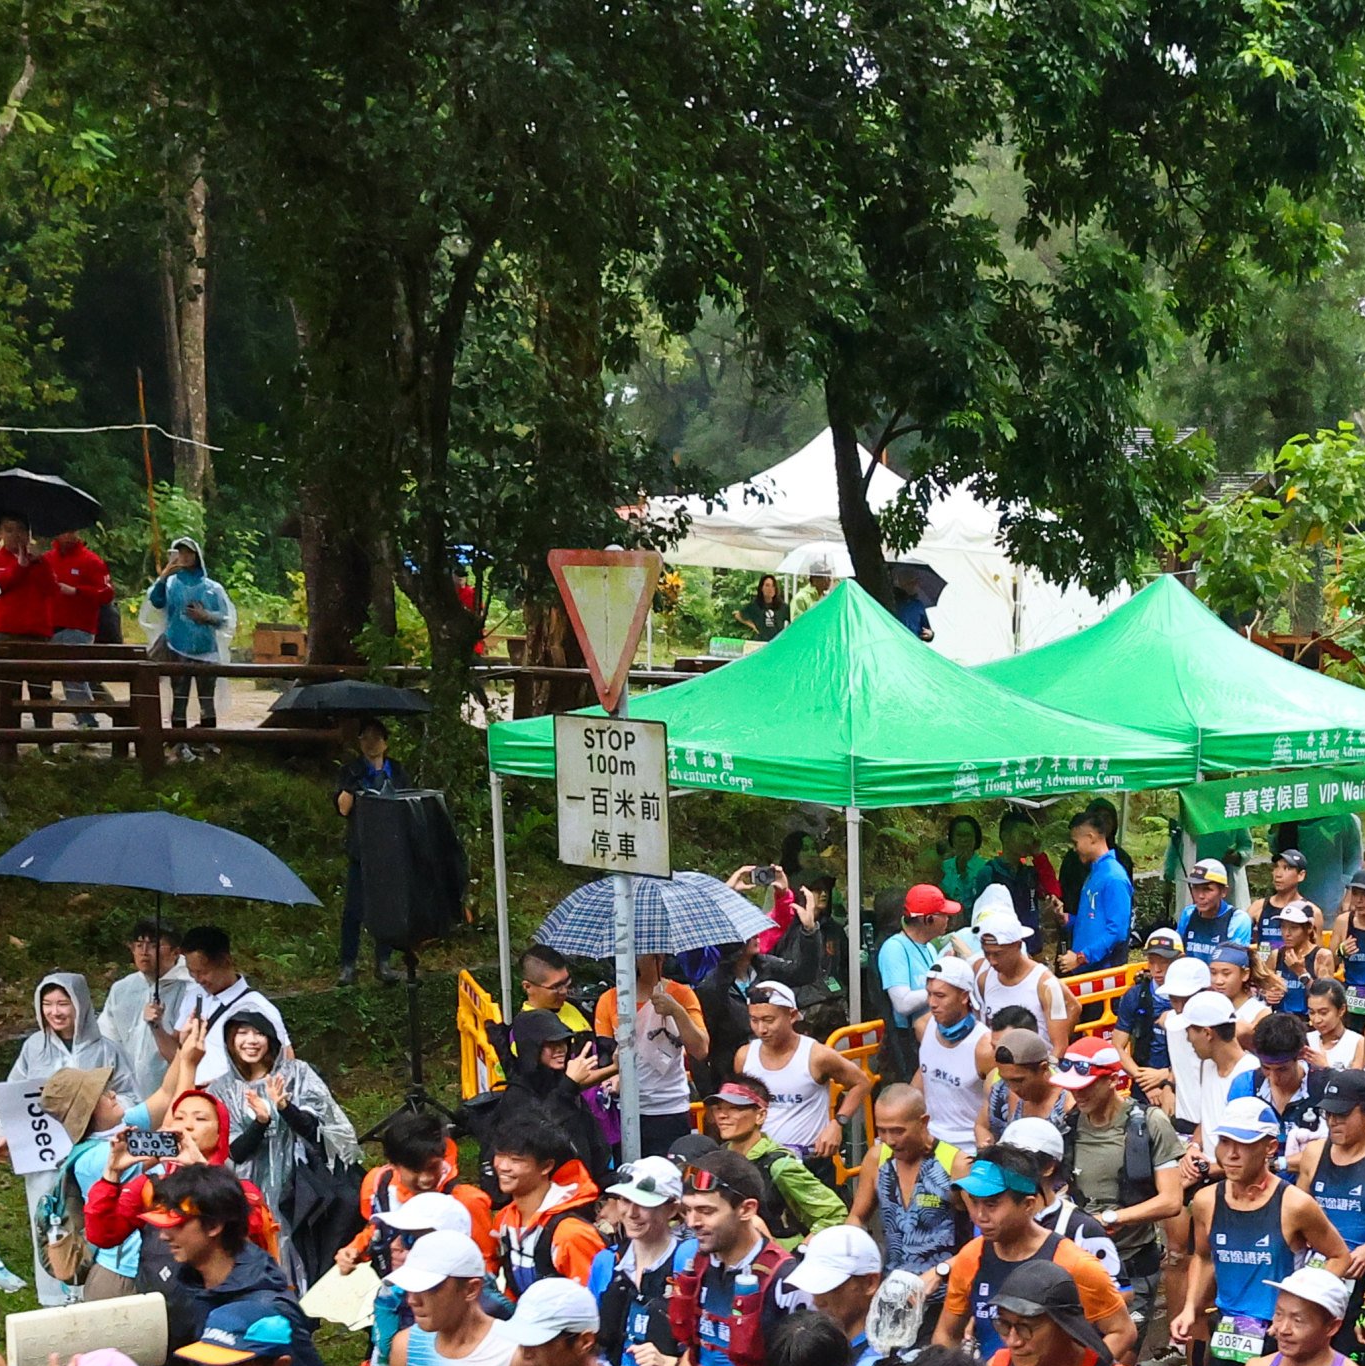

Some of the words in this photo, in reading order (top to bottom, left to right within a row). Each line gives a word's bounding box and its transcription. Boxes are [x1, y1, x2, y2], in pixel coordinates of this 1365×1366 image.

[584, 727, 636, 752] STOP
[587, 753, 636, 777] 100m
[667, 746, 734, 771] 年領袖團
[1295, 747, 1317, 761] Hong
[1318, 746, 1339, 760] Kong
[667, 767, 713, 785] dventure
[715, 770, 754, 791] Corps
[984, 776, 1013, 794] Hong
[1015, 773, 1043, 791] Kong
[1045, 770, 1093, 787] Adventure
[1096, 766, 1125, 785] Corps
[566, 786, 660, 822] 一百米前
[1223, 783, 1309, 818] 嘉賓等候區
[1319, 785, 1338, 805] VIP
[591, 829, 637, 861] 停車
[921, 1063, 961, 1087] DRK45
[769, 1093, 803, 1104] RK45
[1216, 1249, 1272, 1265] 富途證券
[1216, 1333, 1253, 1352] 8087A
